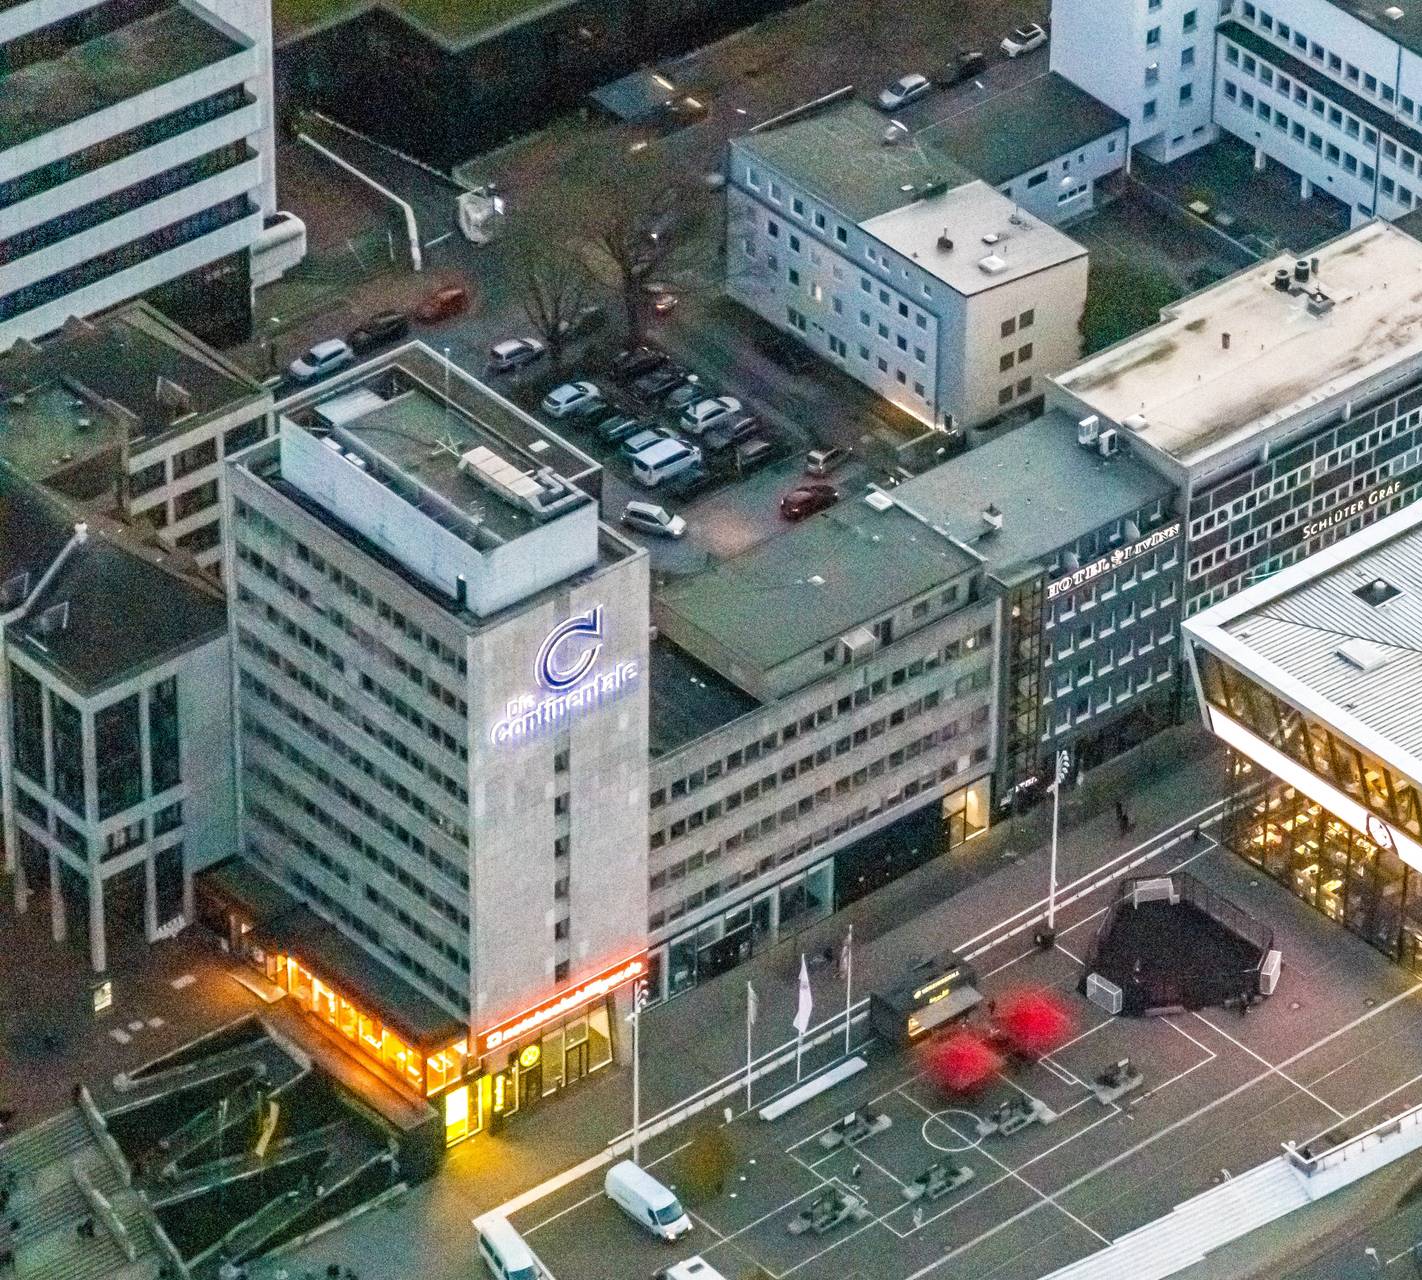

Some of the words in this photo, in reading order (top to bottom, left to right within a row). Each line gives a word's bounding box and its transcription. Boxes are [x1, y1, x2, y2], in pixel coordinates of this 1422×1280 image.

[1302, 500, 1364, 539] SCHLÜTER
[1368, 481, 1400, 505] GRAF
[1047, 558, 1110, 599] HOTEL
[490, 661, 638, 745] Continentale
